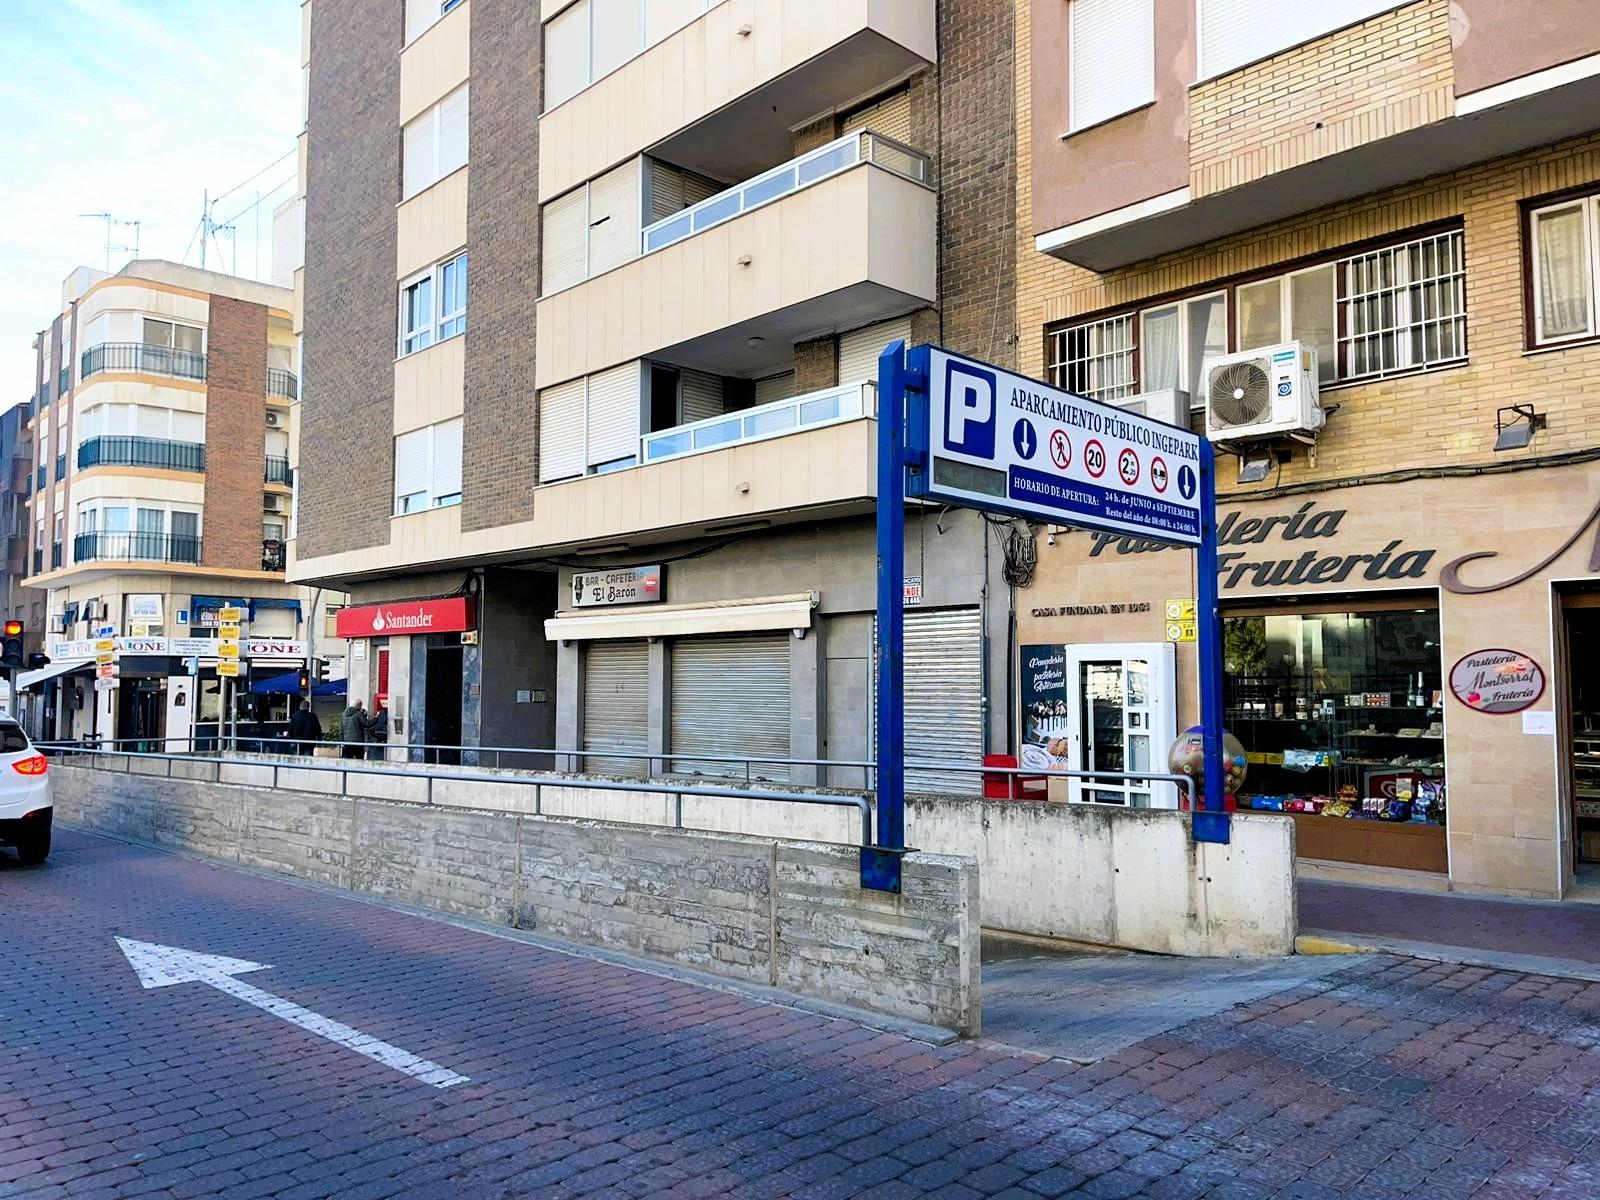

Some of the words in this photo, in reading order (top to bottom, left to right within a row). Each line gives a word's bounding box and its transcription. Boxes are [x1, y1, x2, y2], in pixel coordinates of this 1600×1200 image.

[948, 368, 992, 445] P
[1010, 387, 1101, 434] APARCAMIENTO
[1104, 414, 1150, 446] PÚBLICO
[1151, 431, 1199, 462] INGEPARK
[1088, 449, 1102, 469] 20
[1014, 477, 1050, 495] HORARIO
[1050, 487, 1061, 498] DE
[1061, 489, 1100, 506] APERTURA:
[1105, 492, 1113, 501] 24
[1114, 493, 1120, 503] h.
[1121, 495, 1129, 504] de
[1129, 497, 1152, 509] JUNIO
[1156, 503, 1196, 519] SEPTIEMBRE
[1105, 507, 1122, 518] Resto
[1123, 510, 1132, 520] del
[1133, 513, 1143, 522] año
[1144, 515, 1151, 524] de
[1217, 540, 1436, 589] Frutería
[585, 576, 599, 586] BAR
[592, 587, 605, 602] El
[608, 584, 636, 602] Barón
[386, 608, 433, 629] Santander
[1031, 607, 1057, 617] CASA
[1060, 604, 1108, 616] FUNDADA
[1110, 604, 1125, 614] EN
[1466, 653, 1517, 668] Pastelería
[1492, 688, 1534, 701] Frutería
